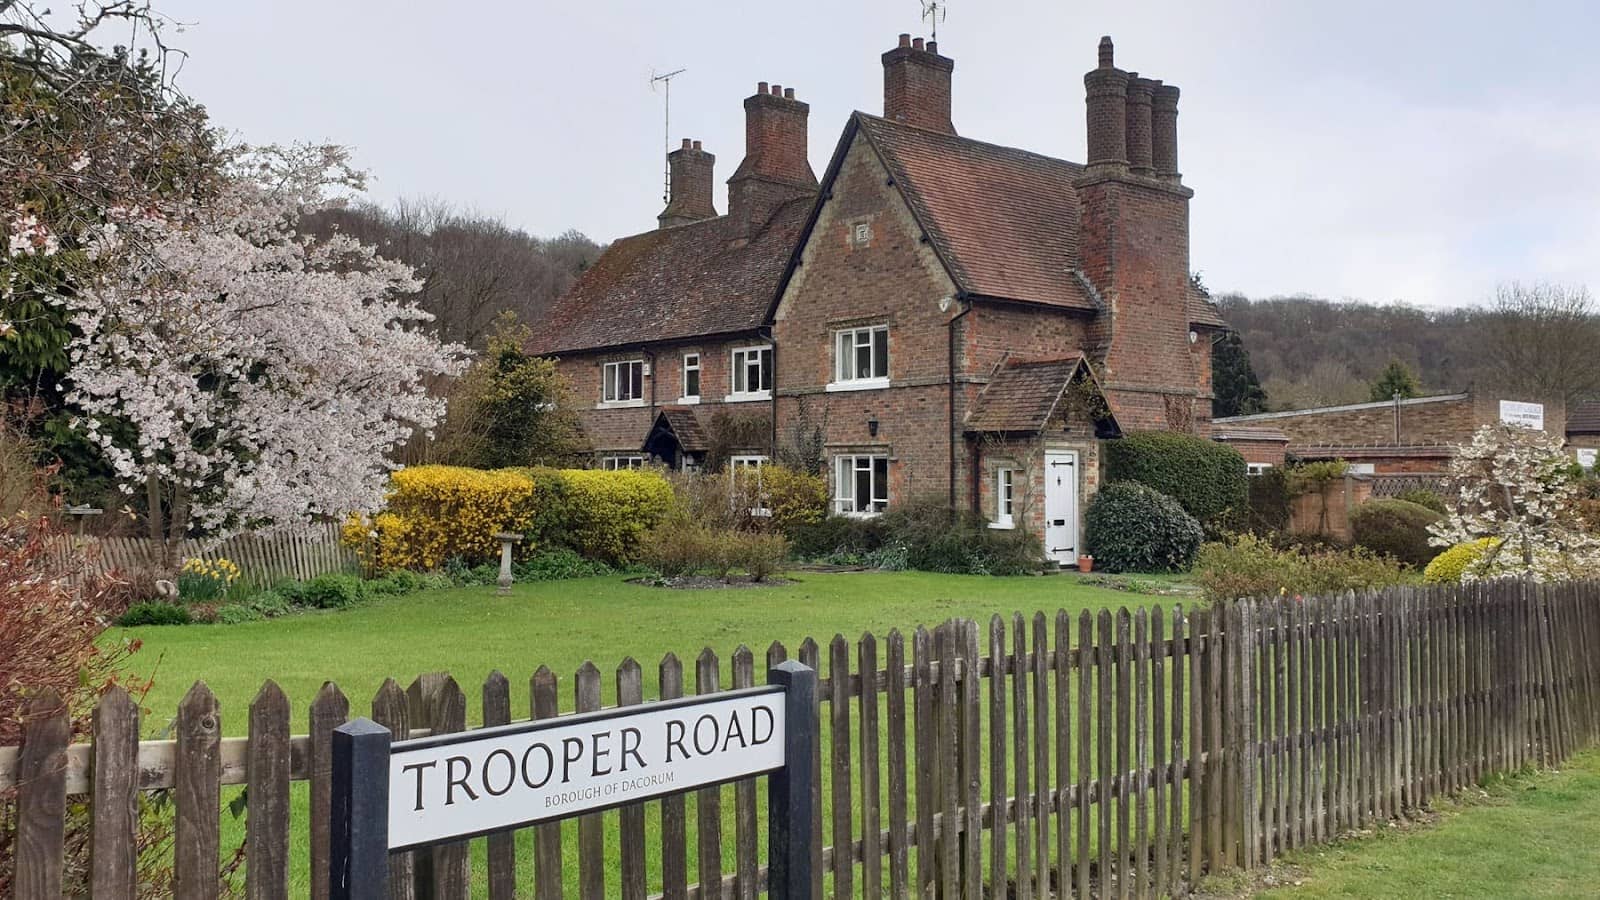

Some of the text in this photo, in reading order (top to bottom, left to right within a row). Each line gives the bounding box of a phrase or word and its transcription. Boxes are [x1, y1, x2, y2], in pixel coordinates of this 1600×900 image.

[402, 706, 775, 811] TROOPER ROAD
[545, 771, 675, 808] BOROUGH OF DACORUM
